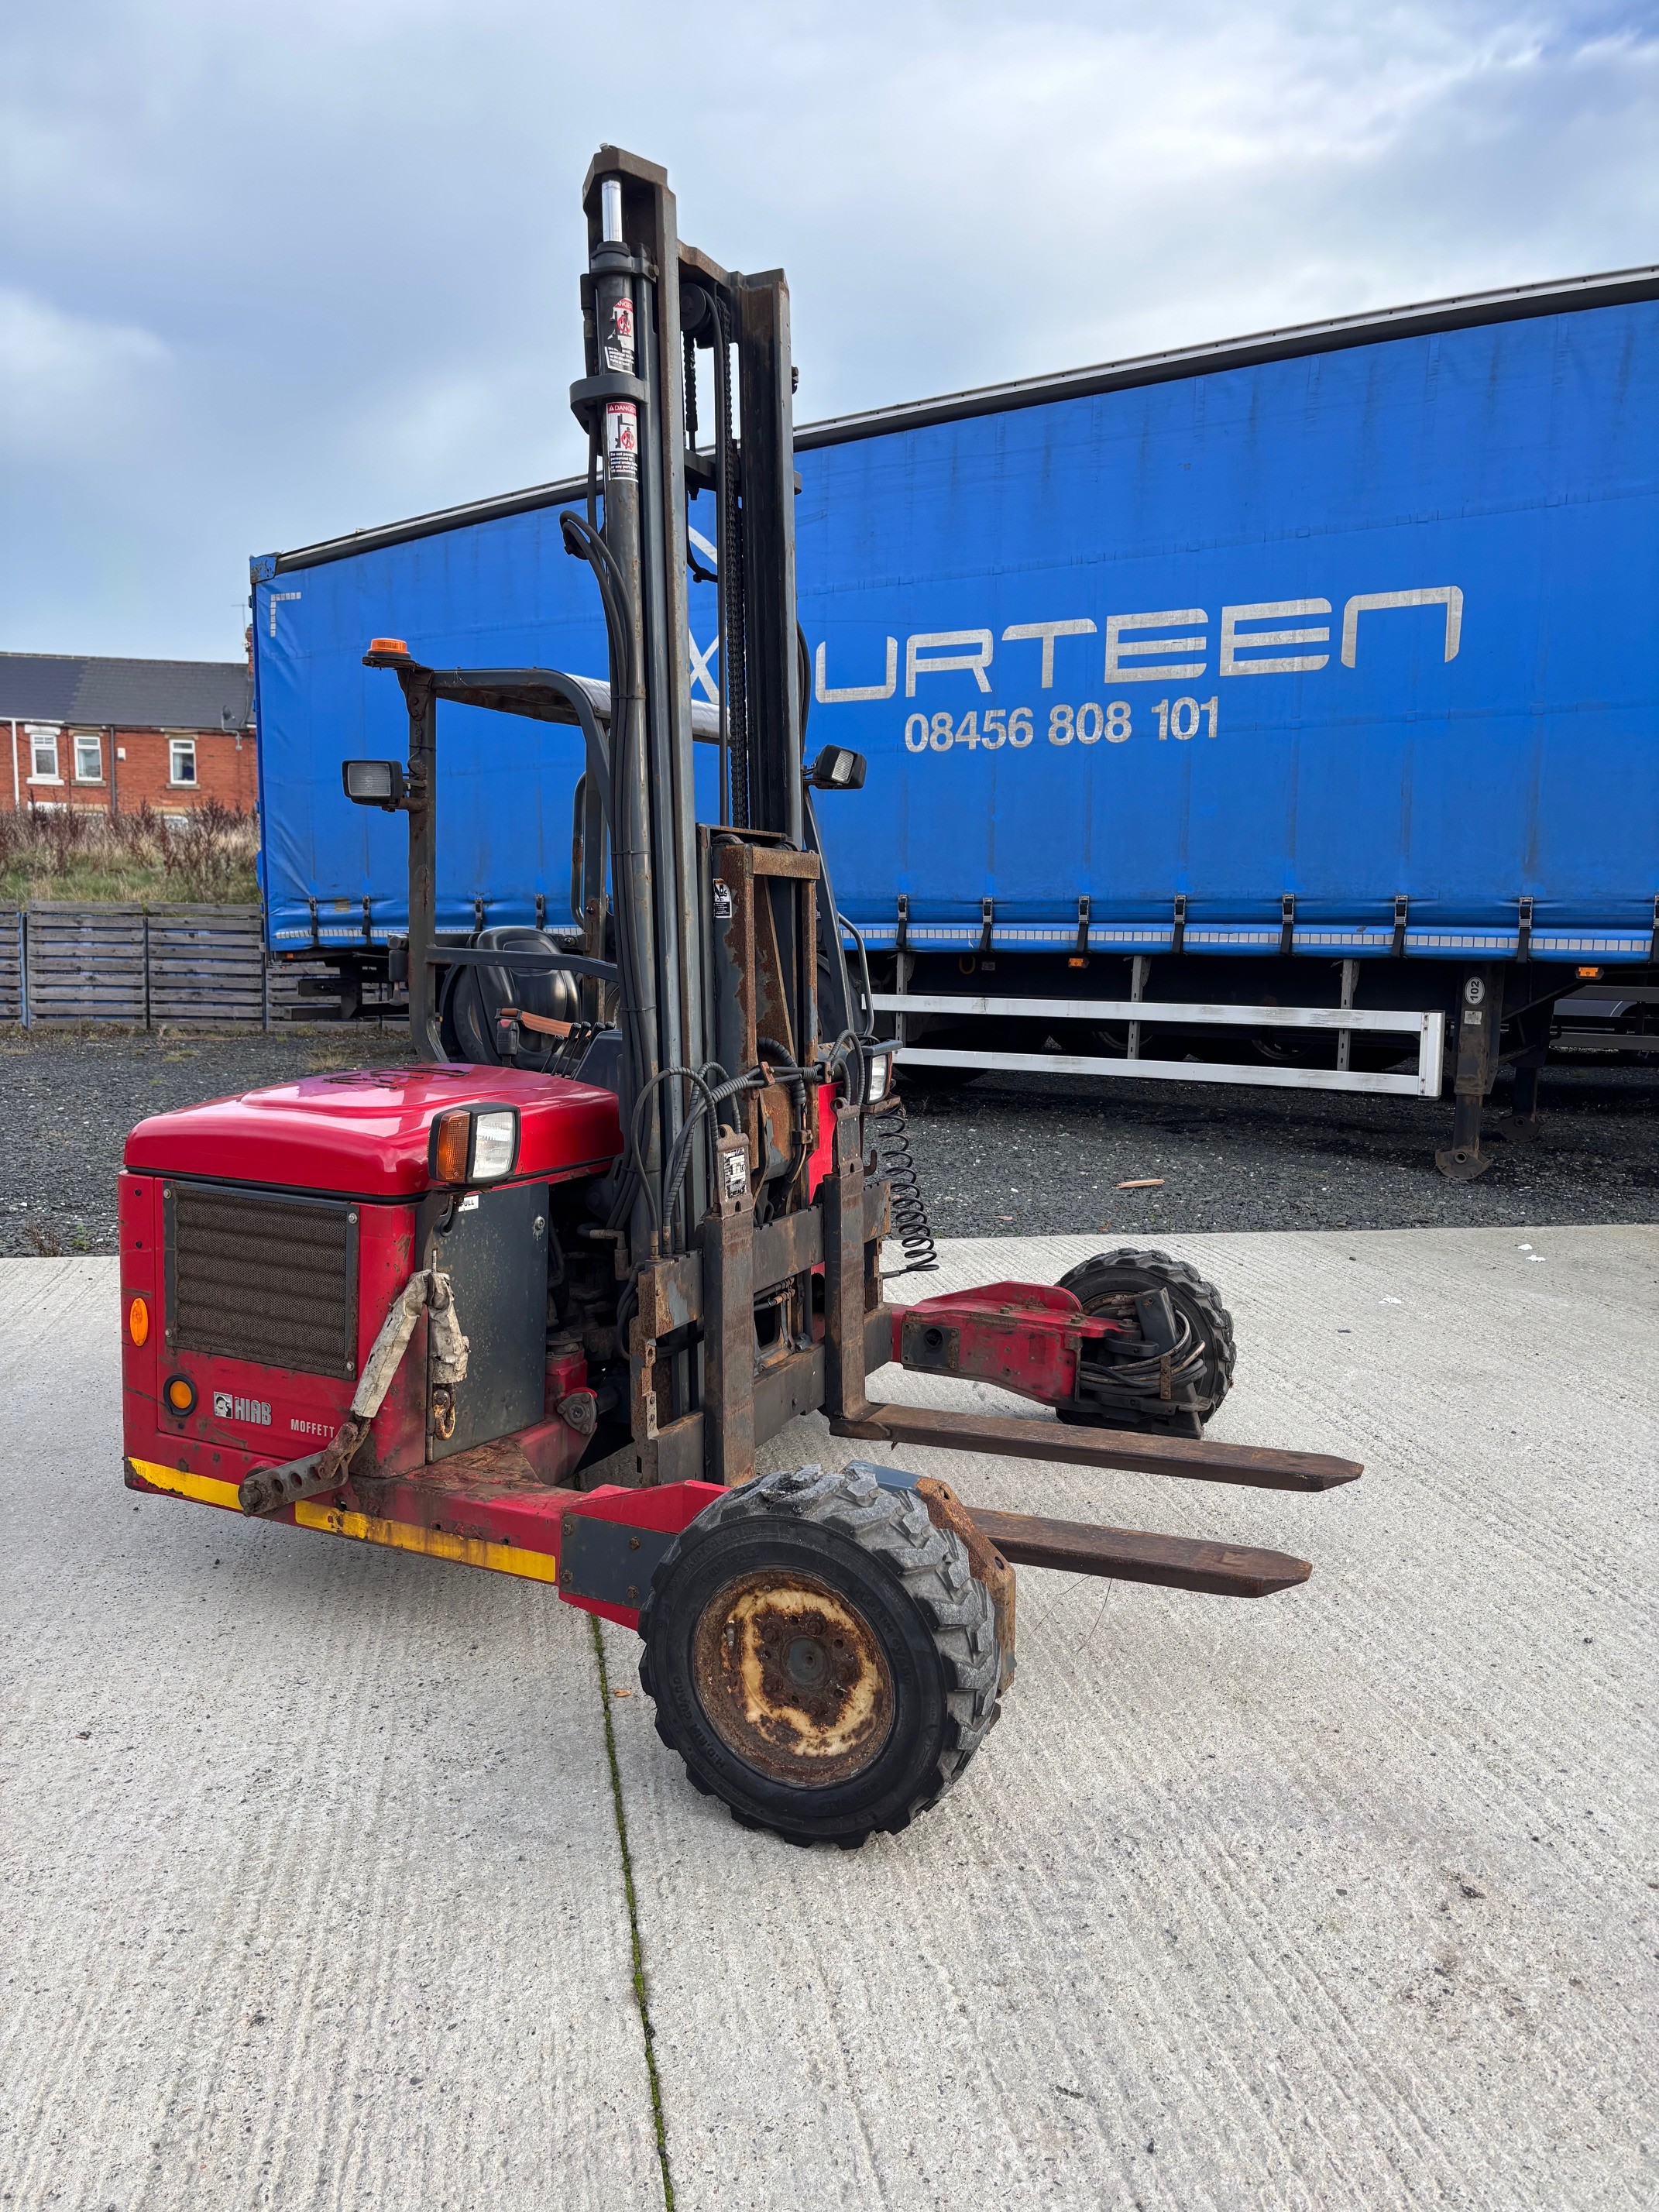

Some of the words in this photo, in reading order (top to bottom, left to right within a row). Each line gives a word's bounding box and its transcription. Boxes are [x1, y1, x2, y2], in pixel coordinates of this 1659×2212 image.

[905, 707, 1033, 752] 08456
[1049, 701, 1132, 745] 808
[1152, 696, 1218, 740] 101
[1470, 981, 1480, 1001] 102
[235, 1396, 272, 1426] HIAB
[290, 1419, 335, 1438] MOFFETT
